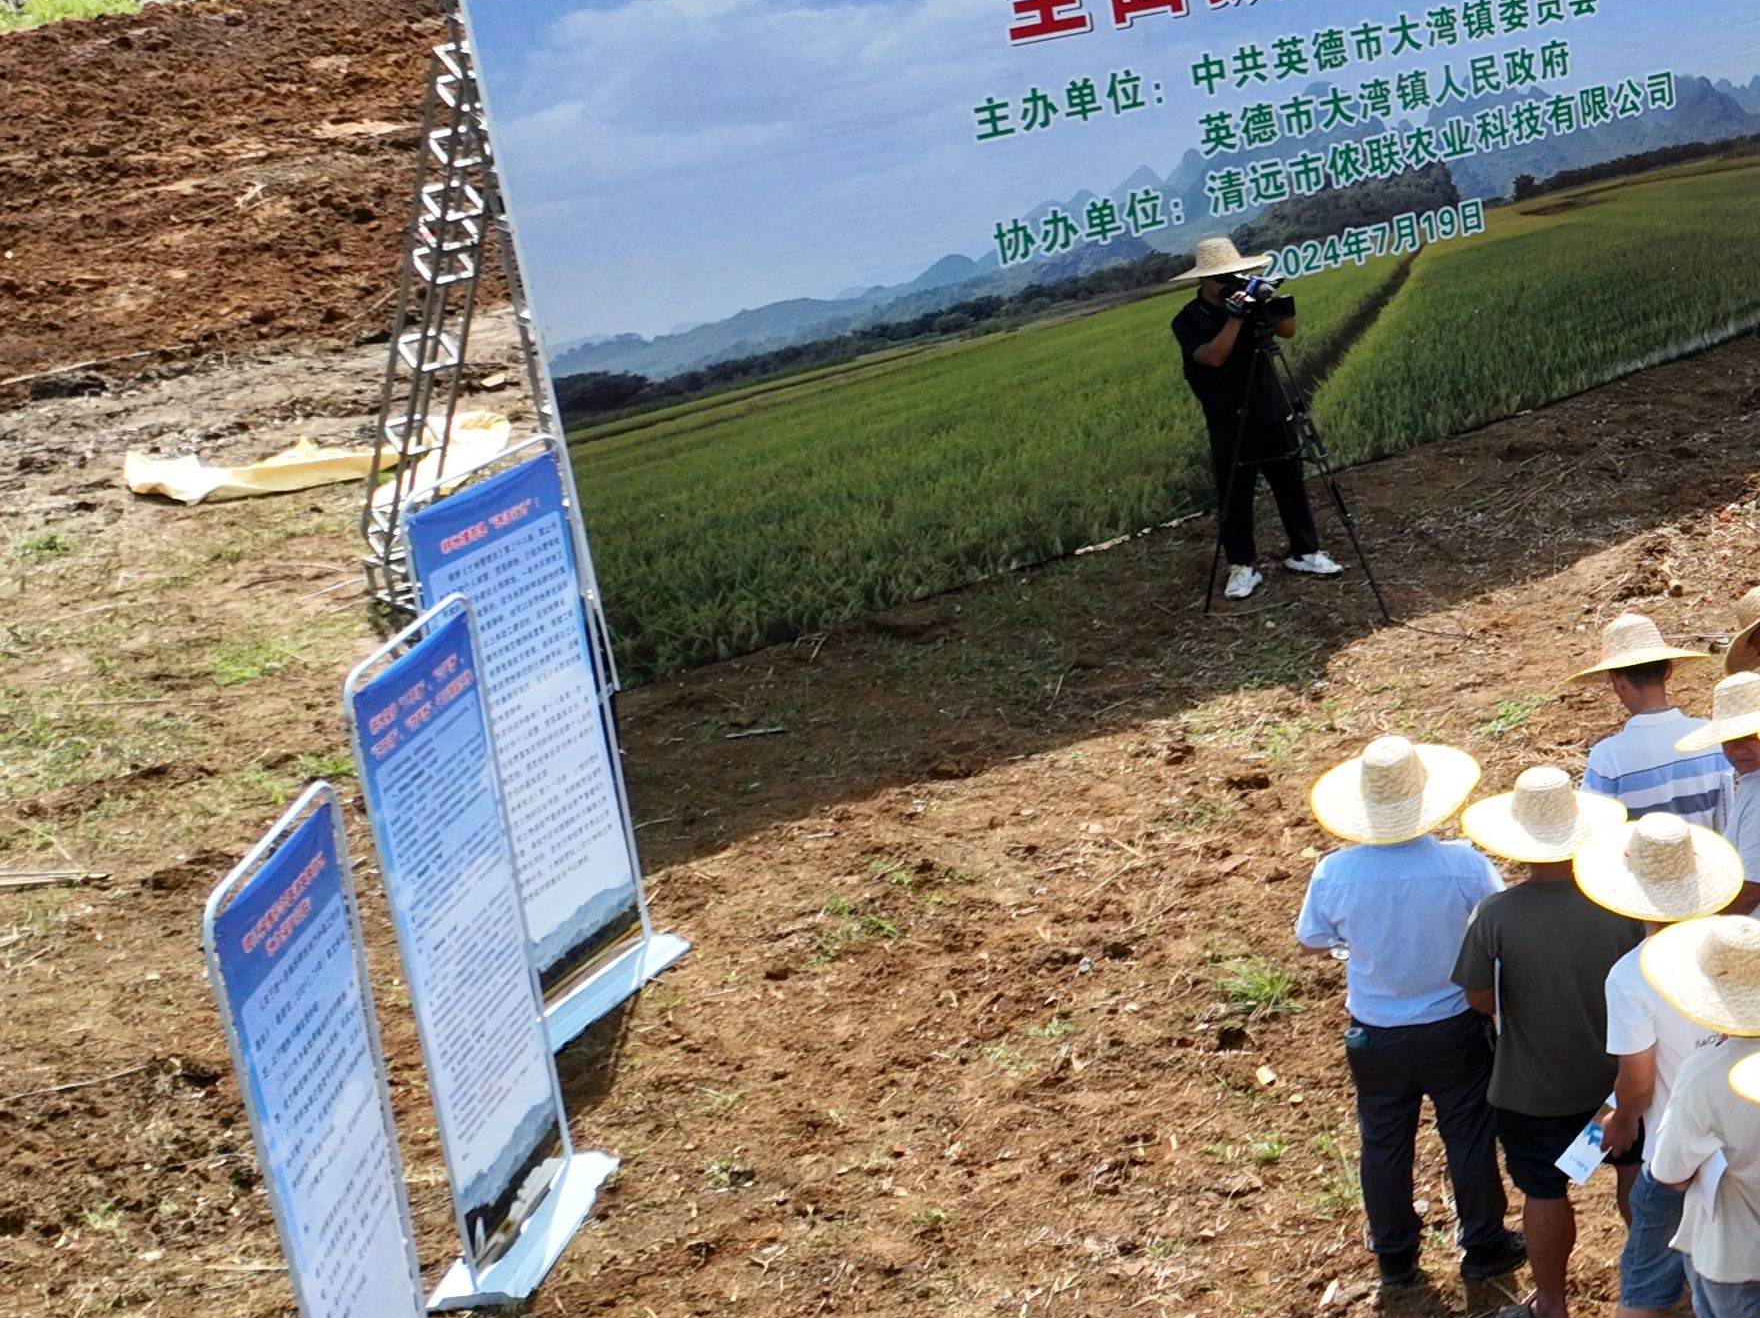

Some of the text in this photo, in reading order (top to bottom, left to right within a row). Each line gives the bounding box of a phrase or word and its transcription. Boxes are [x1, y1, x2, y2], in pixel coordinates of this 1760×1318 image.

[973, 69, 1164, 141] 主办单位：
[1198, 39, 1570, 156] 英德市大湾镇人民政府
[993, 71, 1675, 264] 协办单位： 清远市侬联农业科技有限公司
[1266, 200, 1485, 278] 2024年7月19日
